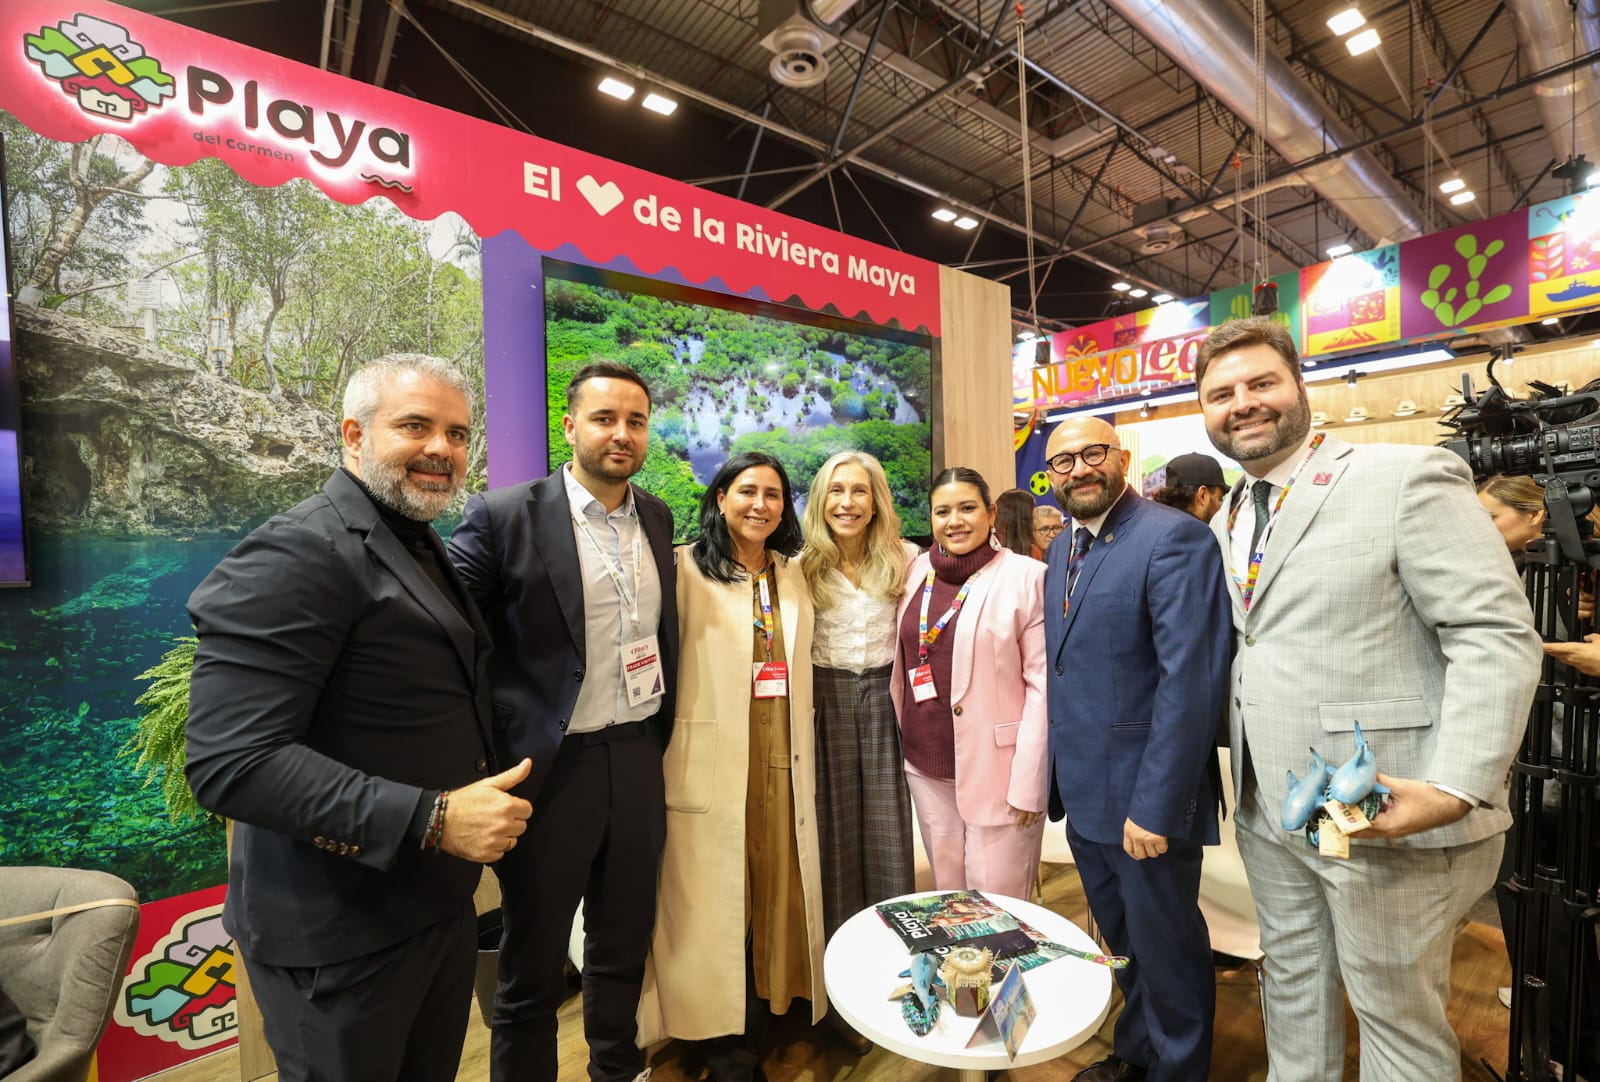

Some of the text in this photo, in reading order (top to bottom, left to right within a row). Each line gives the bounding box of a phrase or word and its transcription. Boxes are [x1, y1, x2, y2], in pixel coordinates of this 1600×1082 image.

[187, 65, 411, 168] Playa
[193, 131, 221, 146] del
[523, 161, 916, 296] El de la Riviera Maya
[894, 911, 928, 939] Playa
